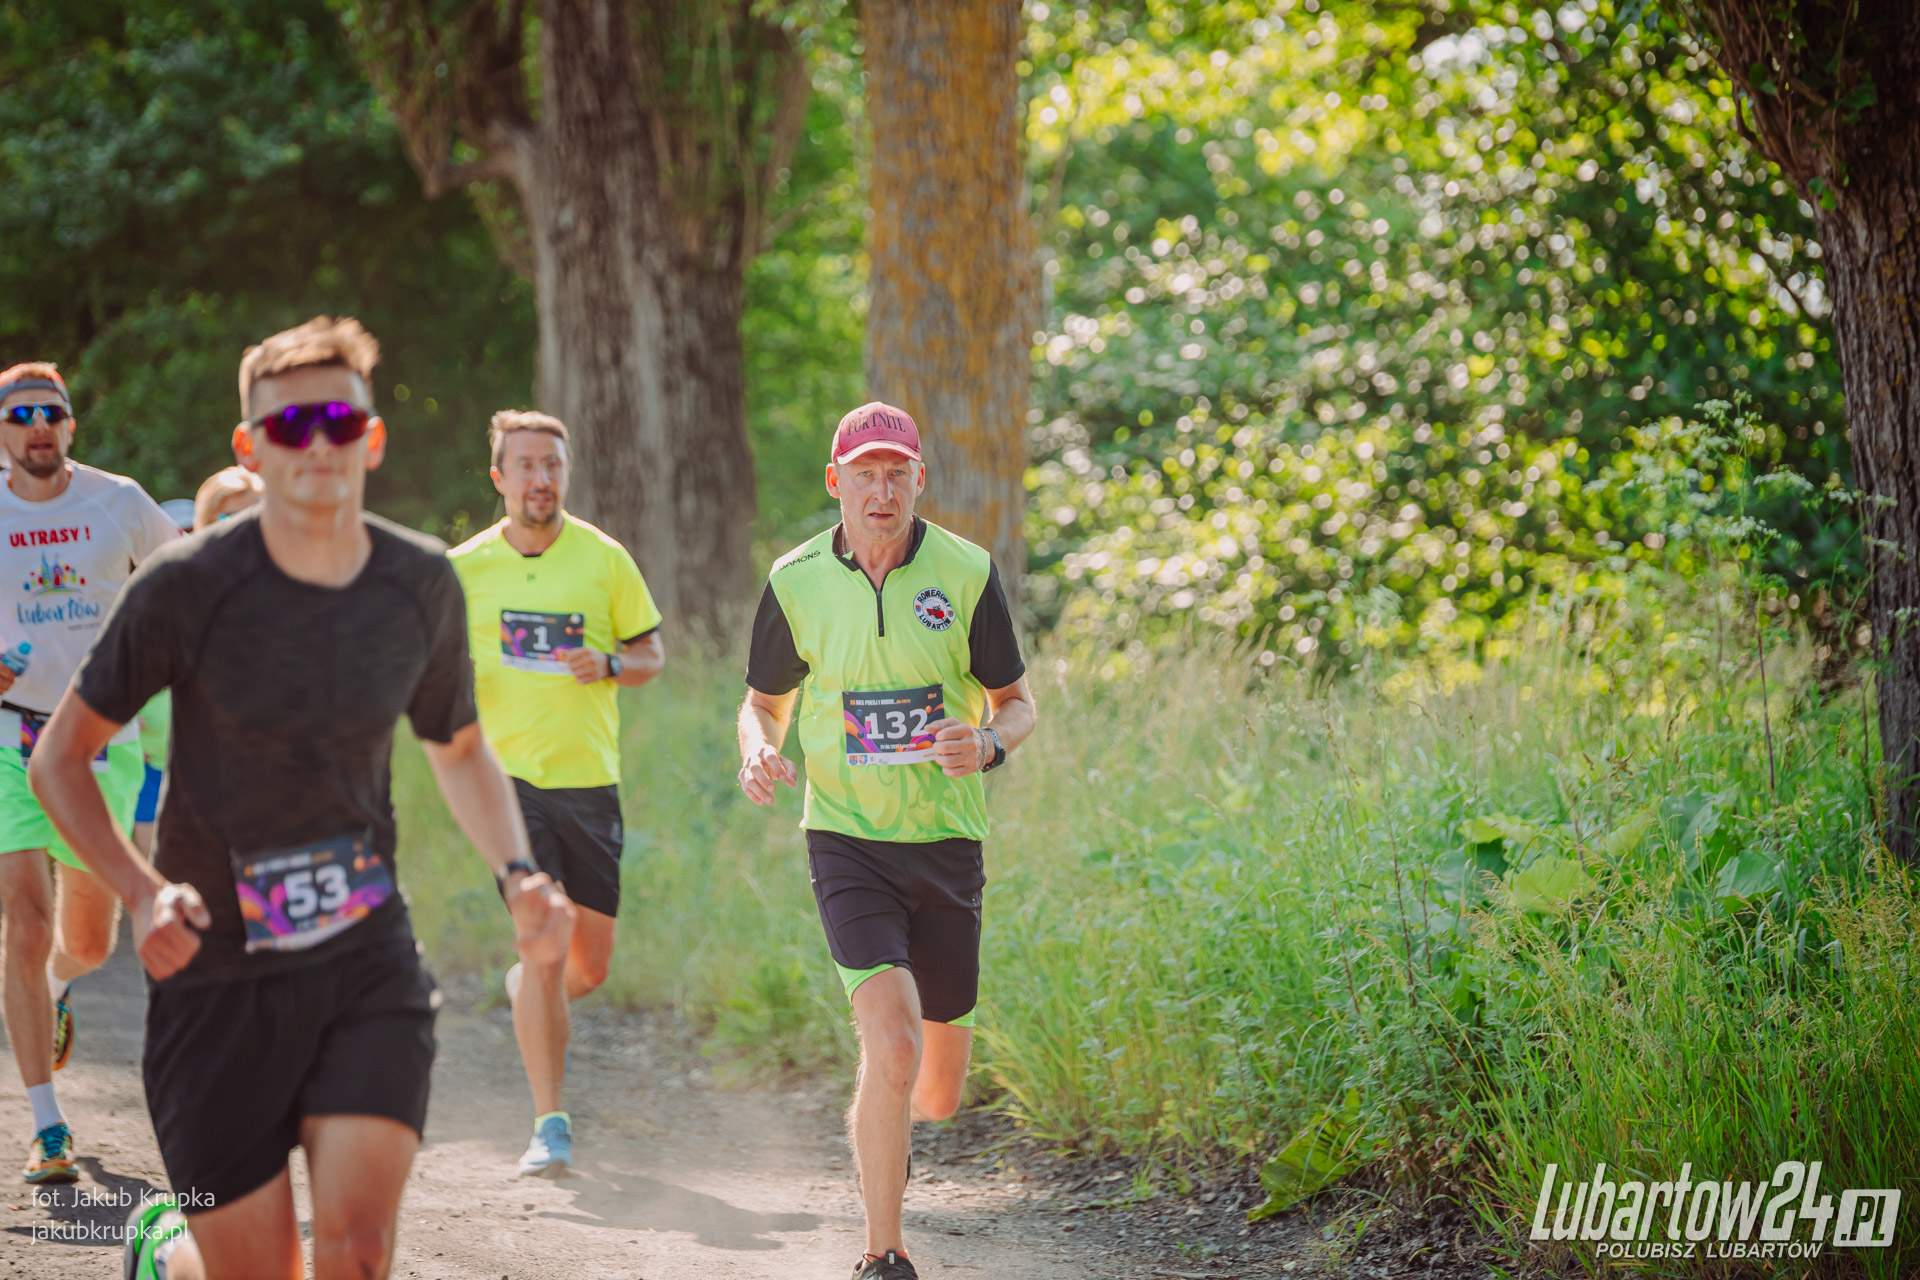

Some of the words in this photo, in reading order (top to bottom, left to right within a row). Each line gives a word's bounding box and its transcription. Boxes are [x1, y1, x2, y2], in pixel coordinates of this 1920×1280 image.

[9, 527, 79, 548] ULTRASY
[84, 526, 91, 541] !
[533, 626, 551, 651] 1
[864, 708, 928, 739] 132
[284, 864, 350, 919] 53
